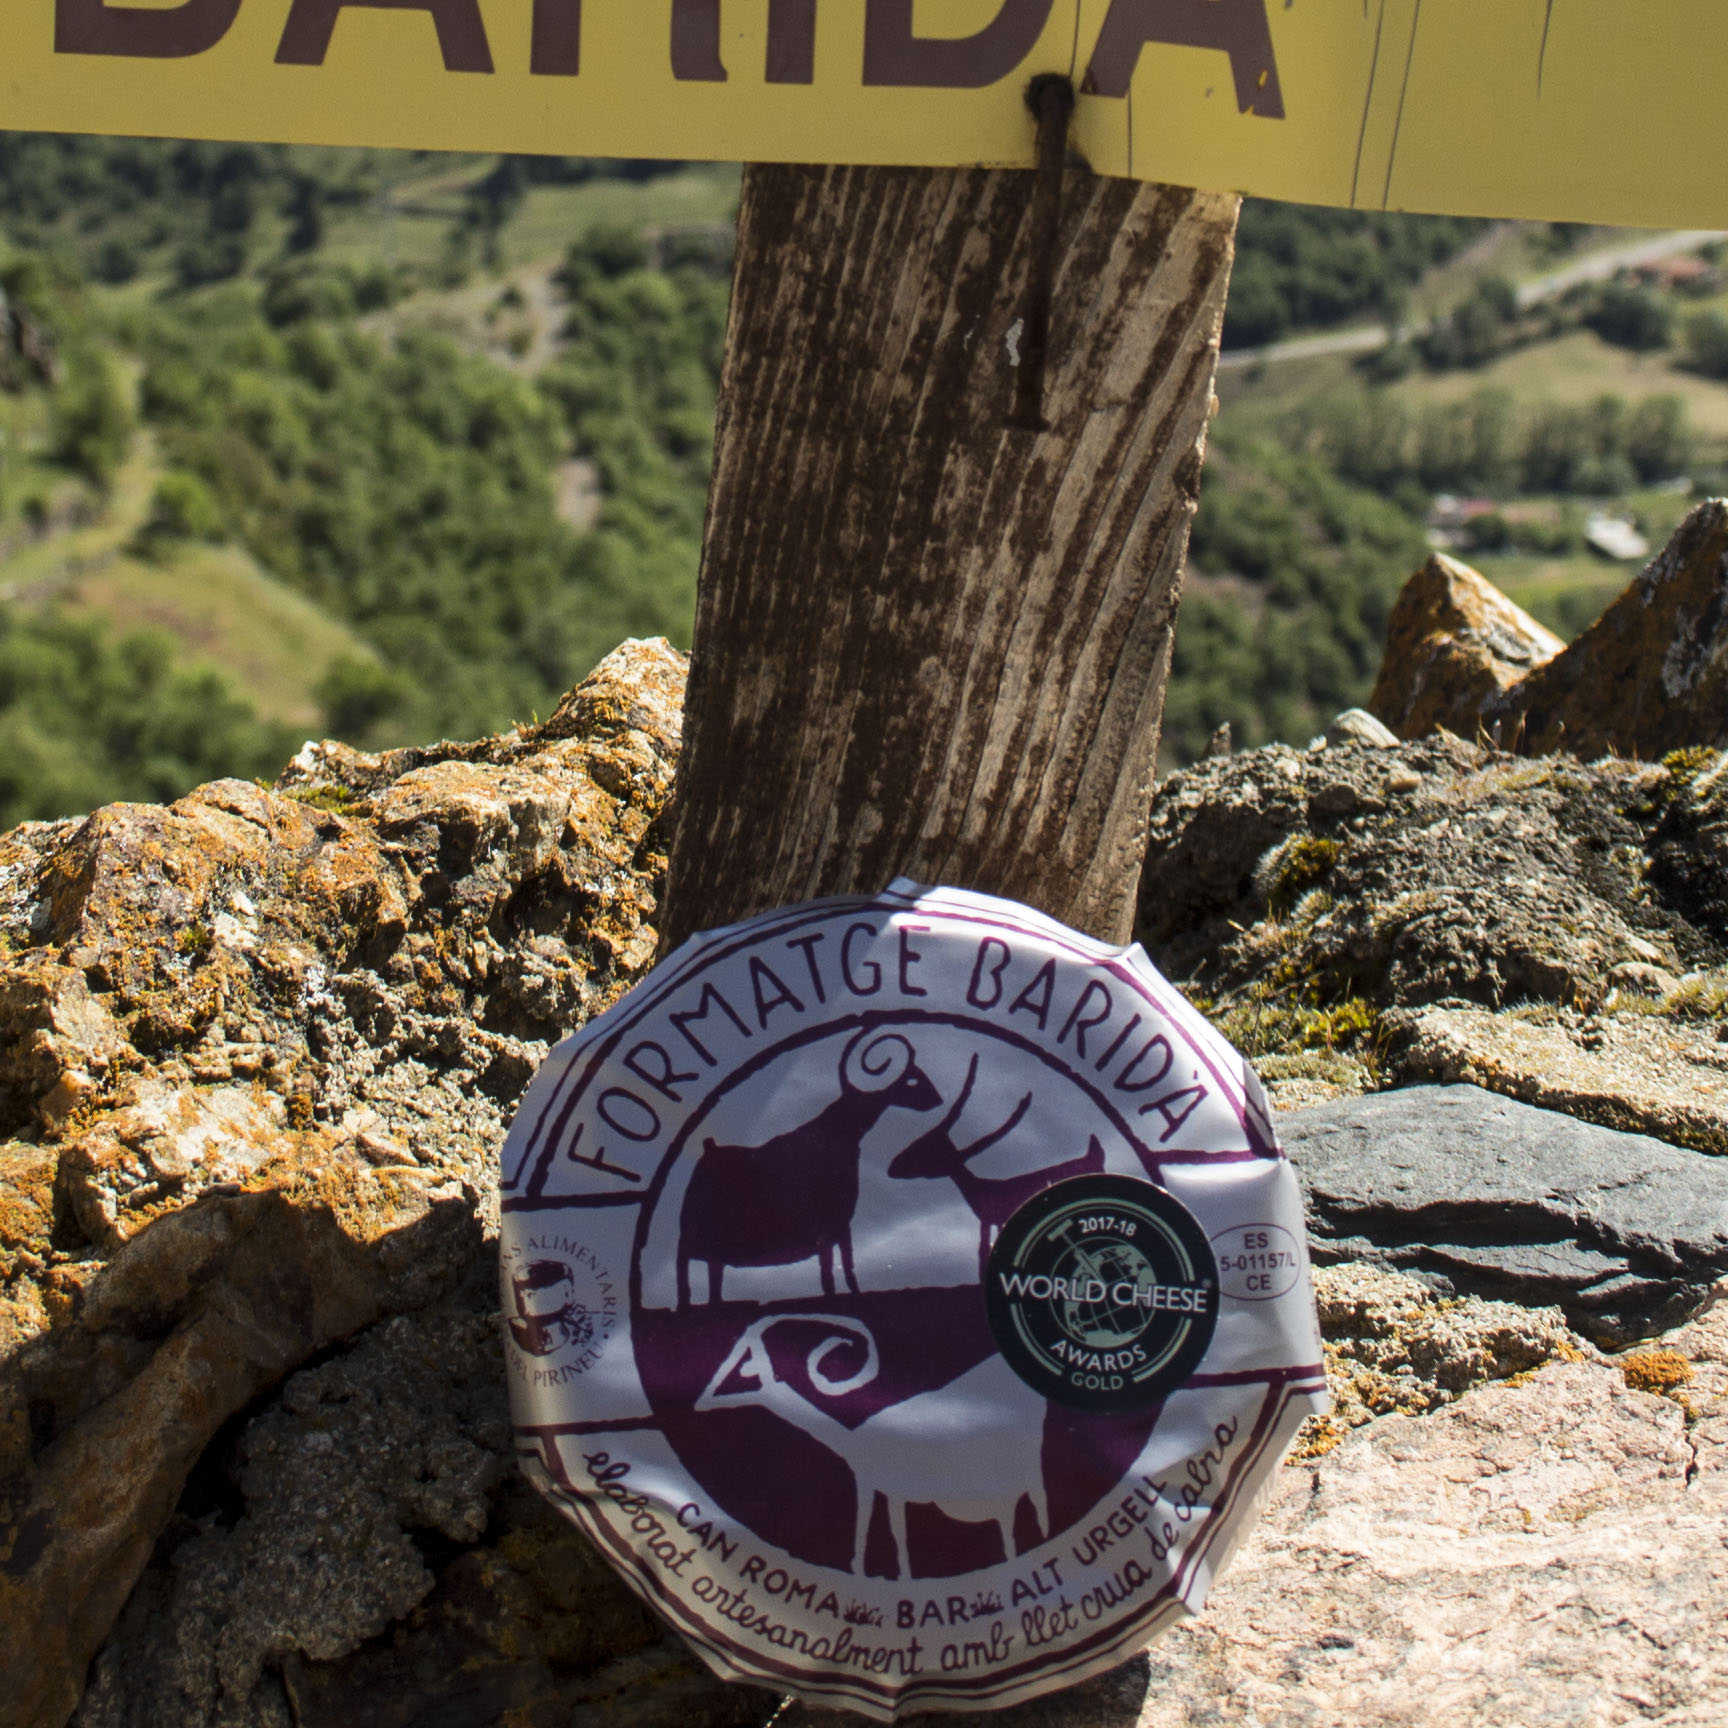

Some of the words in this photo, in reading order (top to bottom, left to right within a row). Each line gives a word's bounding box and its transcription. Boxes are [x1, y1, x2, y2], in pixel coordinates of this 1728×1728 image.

[567, 921, 931, 1182] FORMATGE
[965, 936, 1209, 1143] BARIDÀ
[1077, 1216, 1137, 1237] 2017-18
[1244, 1233, 1268, 1249] ES
[527, 1234, 617, 1330] ALIMENTARIS
[999, 1272, 1107, 1304] WORLD
[1111, 1282, 1208, 1314] CHEESE
[1246, 1275, 1272, 1290] CE
[1050, 1338, 1147, 1372] AWARDS
[1071, 1372, 1124, 1390] GOLD
[582, 1451, 697, 1578] elaborat
[692, 1575, 922, 1677] artesanalment
[940, 1621, 1014, 1672] amb
[1021, 1595, 1079, 1647] llet
[1080, 1559, 1153, 1620] crua
[1144, 1522, 1180, 1561] de
[1174, 1415, 1239, 1522] cabra
[676, 1502, 739, 1563] CAN
[739, 1554, 840, 1618] ROMA
[896, 1595, 970, 1629] BAR
[1011, 1556, 1065, 1607] ALT
[1072, 1474, 1167, 1566] URGELL
